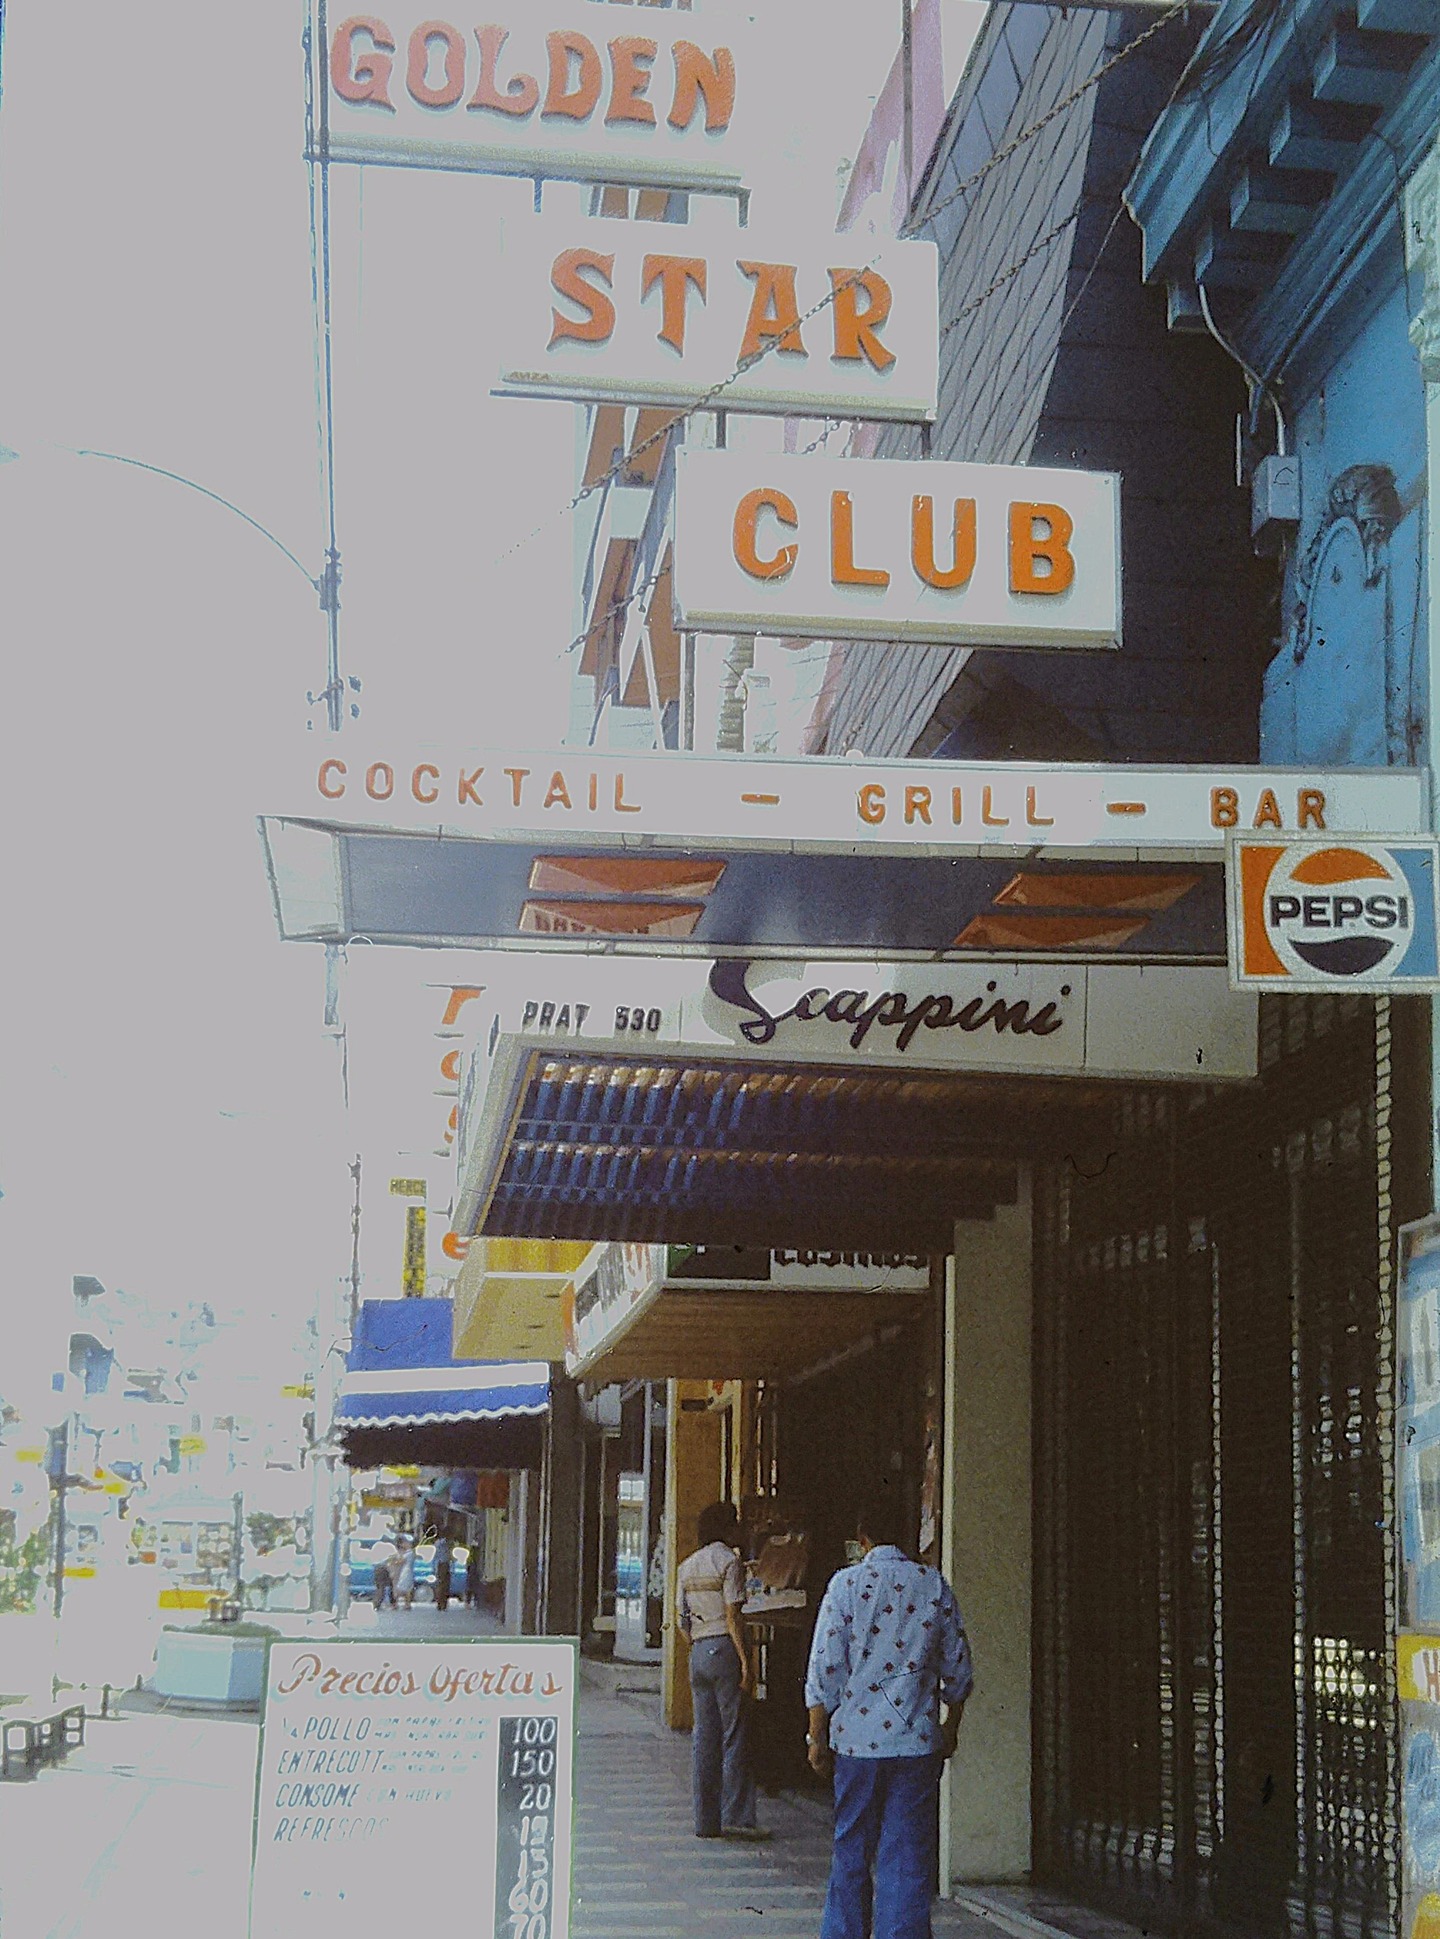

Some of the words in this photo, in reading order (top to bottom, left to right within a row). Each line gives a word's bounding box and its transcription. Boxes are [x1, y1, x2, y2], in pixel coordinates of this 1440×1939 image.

[329, 15, 736, 136] GOLDEN
[546, 247, 897, 374] STAR
[732, 487, 1075, 595] CLUB
[317, 759, 641, 813] COCKTAIL
[857, 783, 1054, 827] GRILL
[1210, 786, 1326, 829] BAR
[1270, 894, 1408, 929] PEPSI
[522, 1001, 591, 1035] PRAT
[614, 1005, 662, 1033] 530
[708, 958, 1072, 1051] Scappini
[277, 1653, 421, 1695] Precios
[428, 1662, 563, 1702] Ofertas
[303, 1716, 371, 1741] POLLO
[512, 1717, 556, 1744] 100
[277, 1749, 384, 1774] ENTRECOTT
[511, 1749, 554, 1776] 150
[275, 1782, 360, 1807] CONSOME
[519, 1783, 552, 1810] 20
[517, 1849, 549, 1879] 15
[508, 1878, 549, 1914] 60
[508, 1912, 547, 1939] 70
